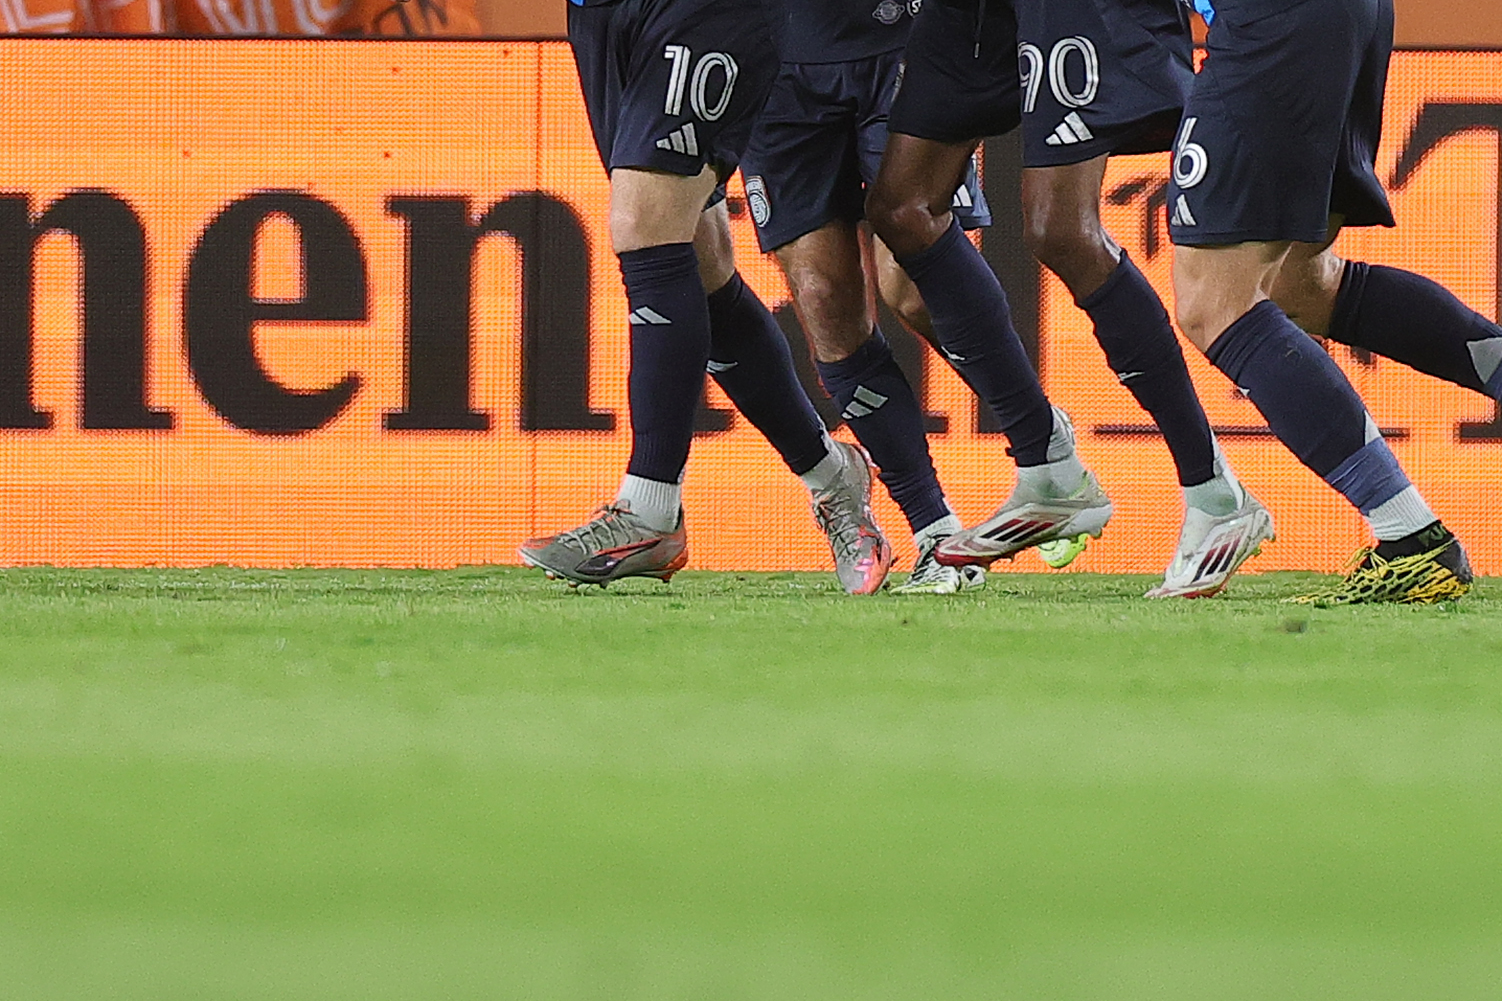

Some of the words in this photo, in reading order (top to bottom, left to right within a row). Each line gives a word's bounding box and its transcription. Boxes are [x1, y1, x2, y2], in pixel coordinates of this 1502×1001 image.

[664, 45, 738, 121] 10
[1018, 35, 1099, 112] 90
[1173, 117, 1208, 190] 6
